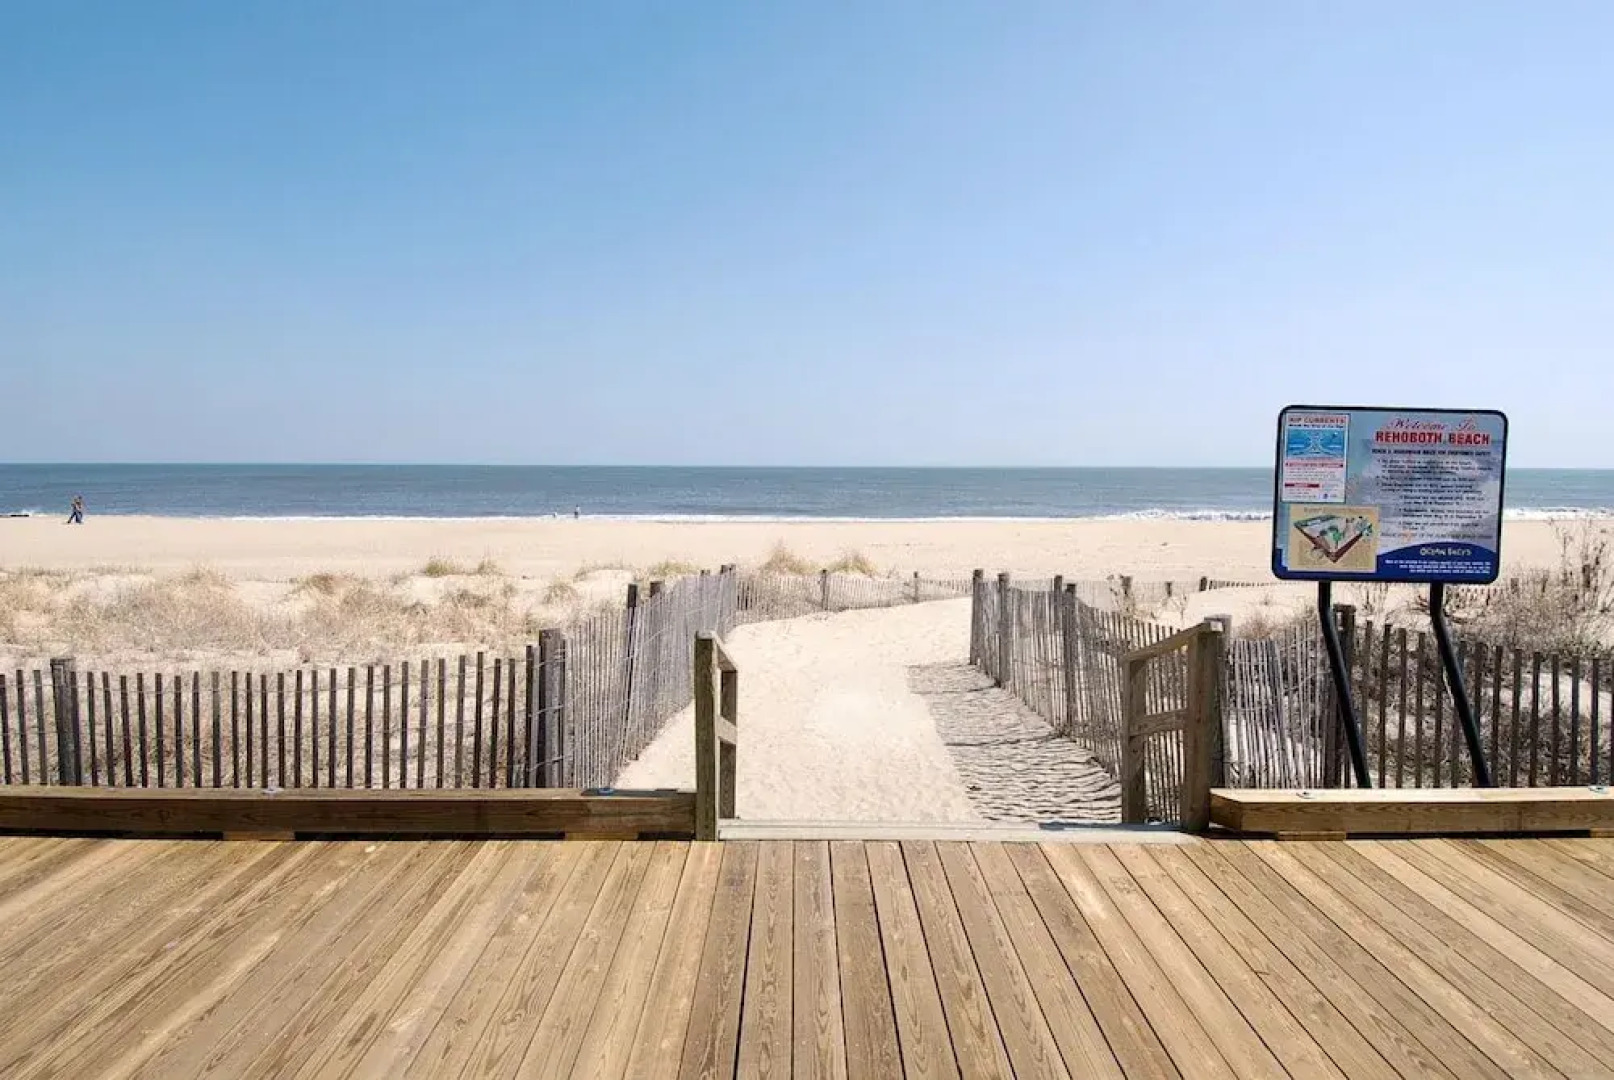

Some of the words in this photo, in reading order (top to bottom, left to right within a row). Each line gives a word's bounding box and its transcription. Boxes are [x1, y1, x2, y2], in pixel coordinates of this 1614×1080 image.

[1387, 417, 1448, 430] Welcome
[1375, 431, 1442, 443] REHOBOTH
[1448, 432, 1491, 445] BEACH
